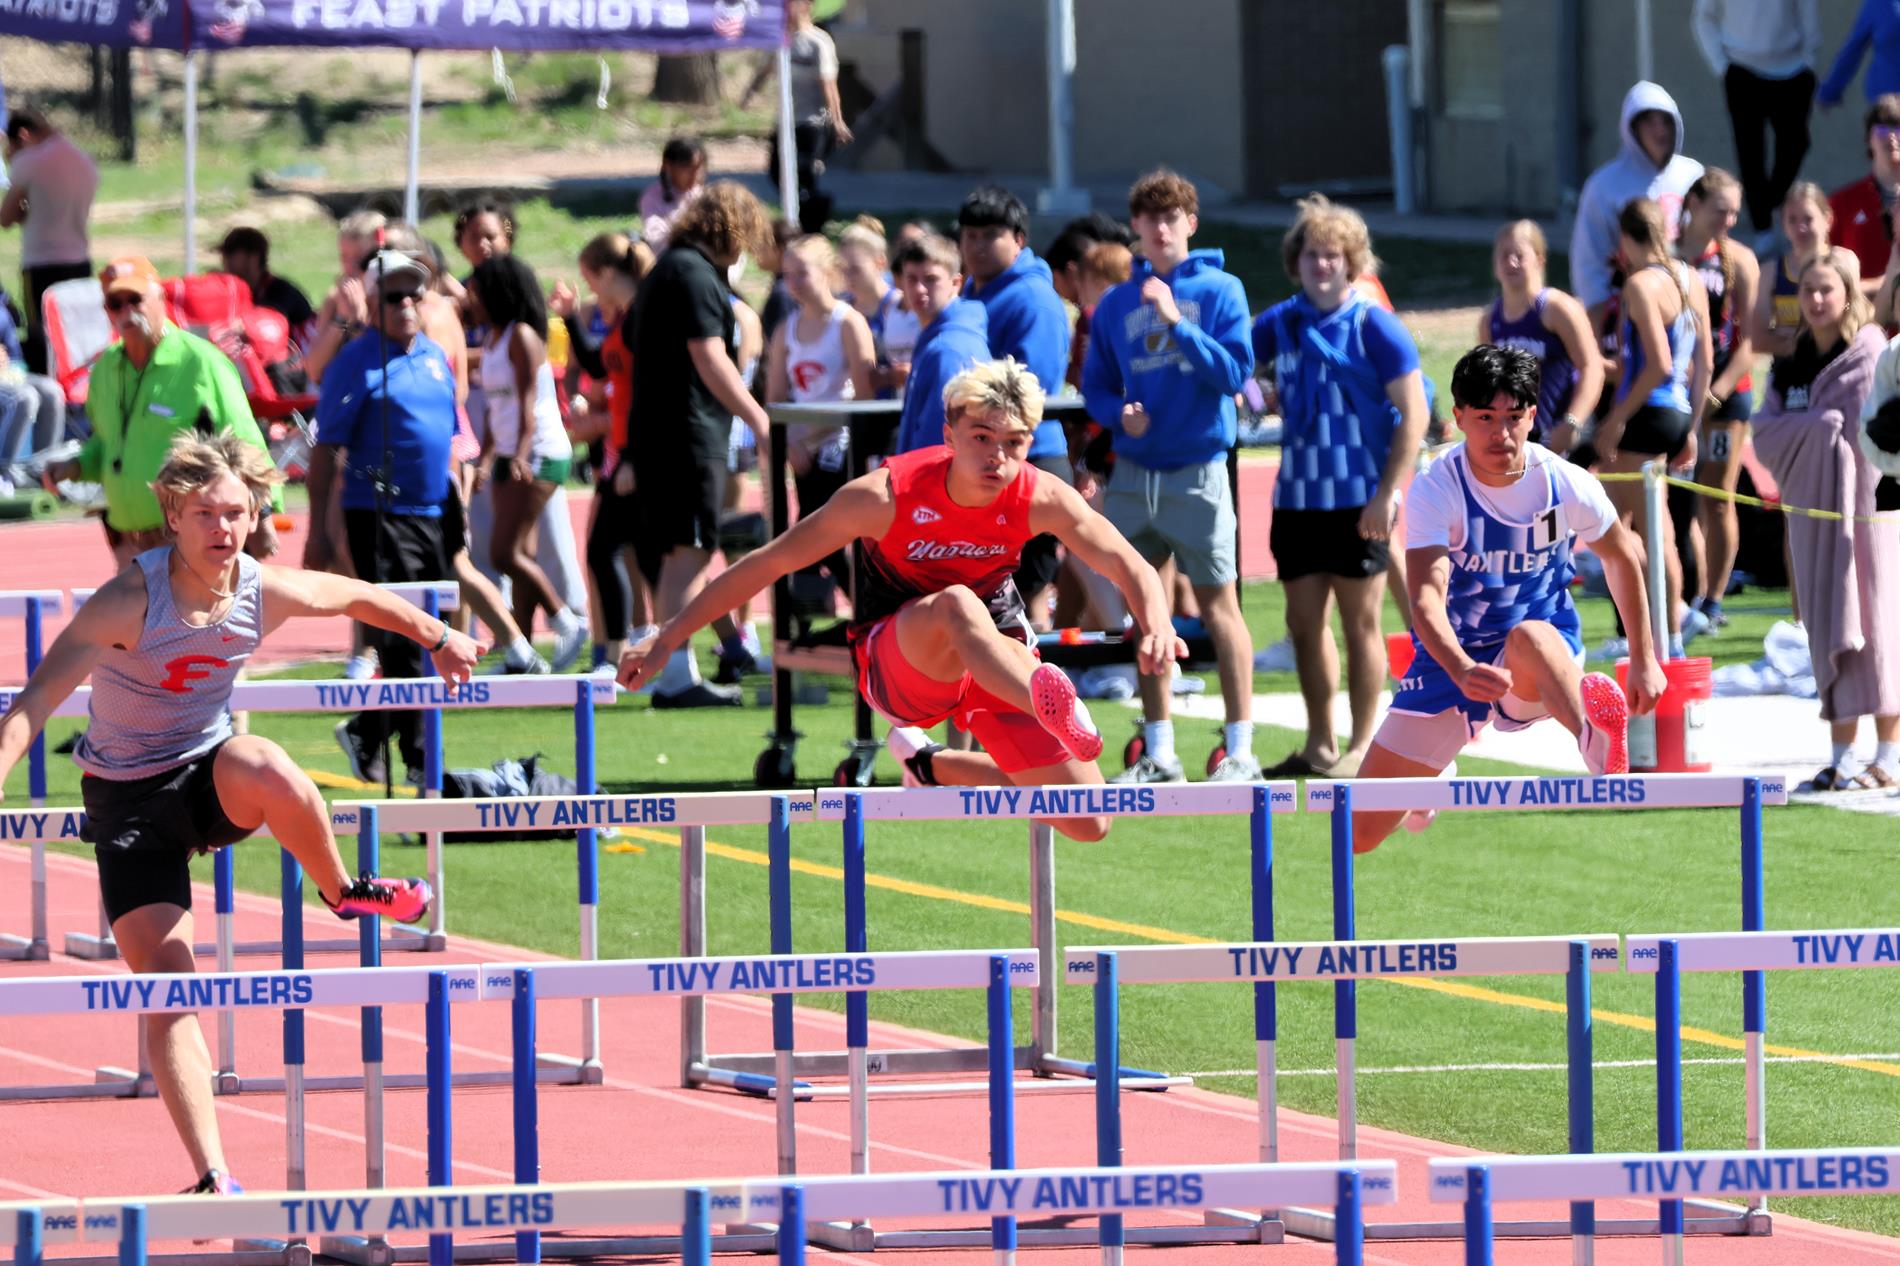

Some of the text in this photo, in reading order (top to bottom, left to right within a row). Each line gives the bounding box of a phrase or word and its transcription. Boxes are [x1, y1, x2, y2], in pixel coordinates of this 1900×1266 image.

[462, 0, 691, 30] PATRIOTS
[1541, 508, 1557, 544] 1
[316, 682, 490, 706] TIVY ANTLERS
[960, 787, 1155, 815] TIVY ANTLERS
[1450, 779, 1646, 805] TIVY ANTLERS
[476, 797, 676, 827] TIVY ANTLERS
[1229, 944, 1457, 976] TIVY ANTLERS
[1792, 934, 1865, 964] TIVY
[647, 958, 876, 991] TIVY ANTLERS
[82, 975, 313, 1010] TIVY ANTLERS
[1622, 1155, 1889, 1193] TIVY ANTLERS
[938, 1173, 1204, 1212] TIVY ANTLERS
[281, 1192, 554, 1233] TIVY ANTLERS
